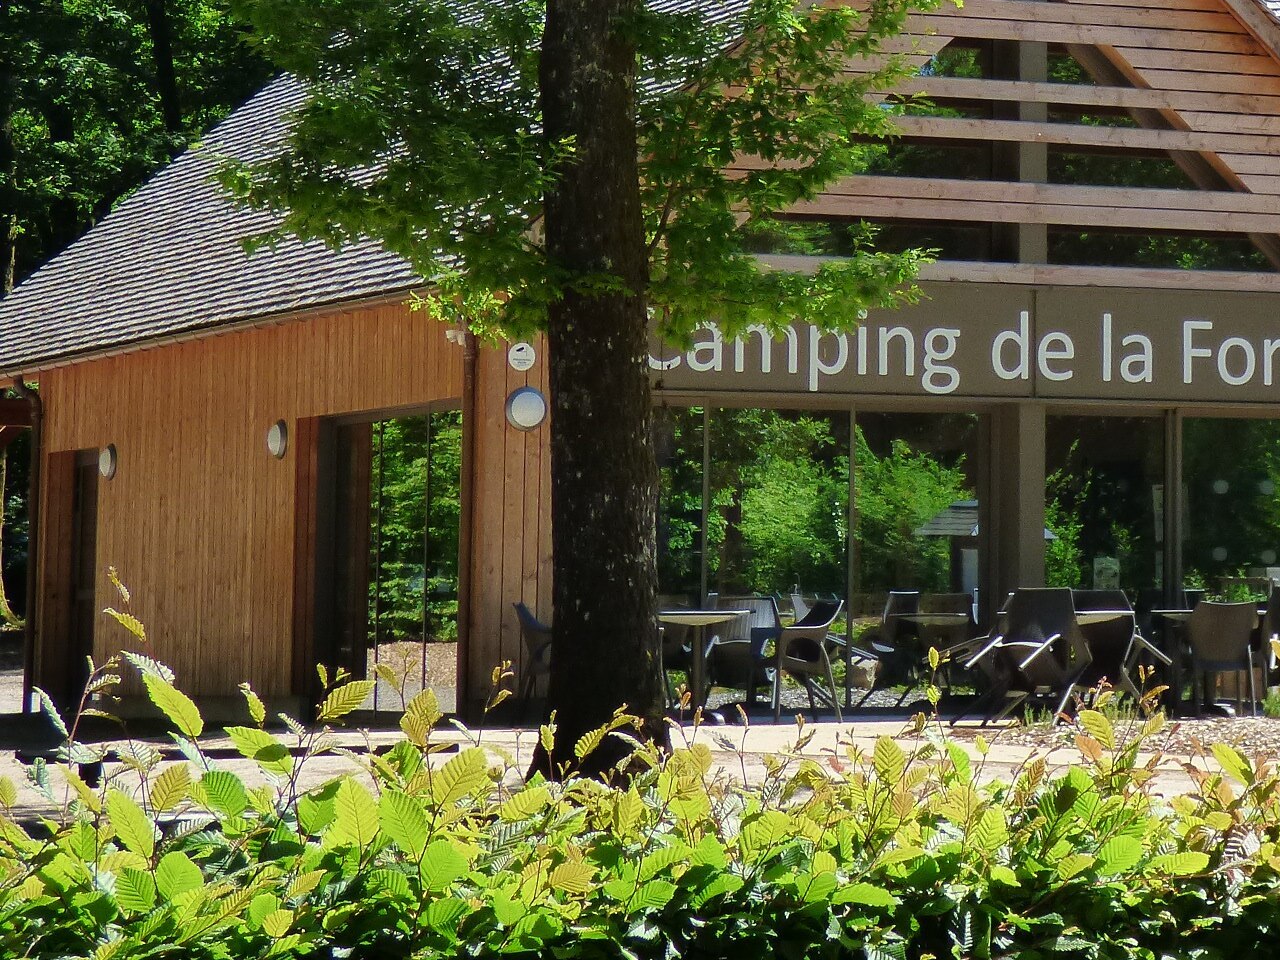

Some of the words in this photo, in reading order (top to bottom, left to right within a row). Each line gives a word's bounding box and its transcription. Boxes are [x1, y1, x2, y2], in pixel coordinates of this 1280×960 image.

[647, 307, 961, 394] amping
[991, 311, 1075, 381] de
[1102, 313, 1153, 383] la
